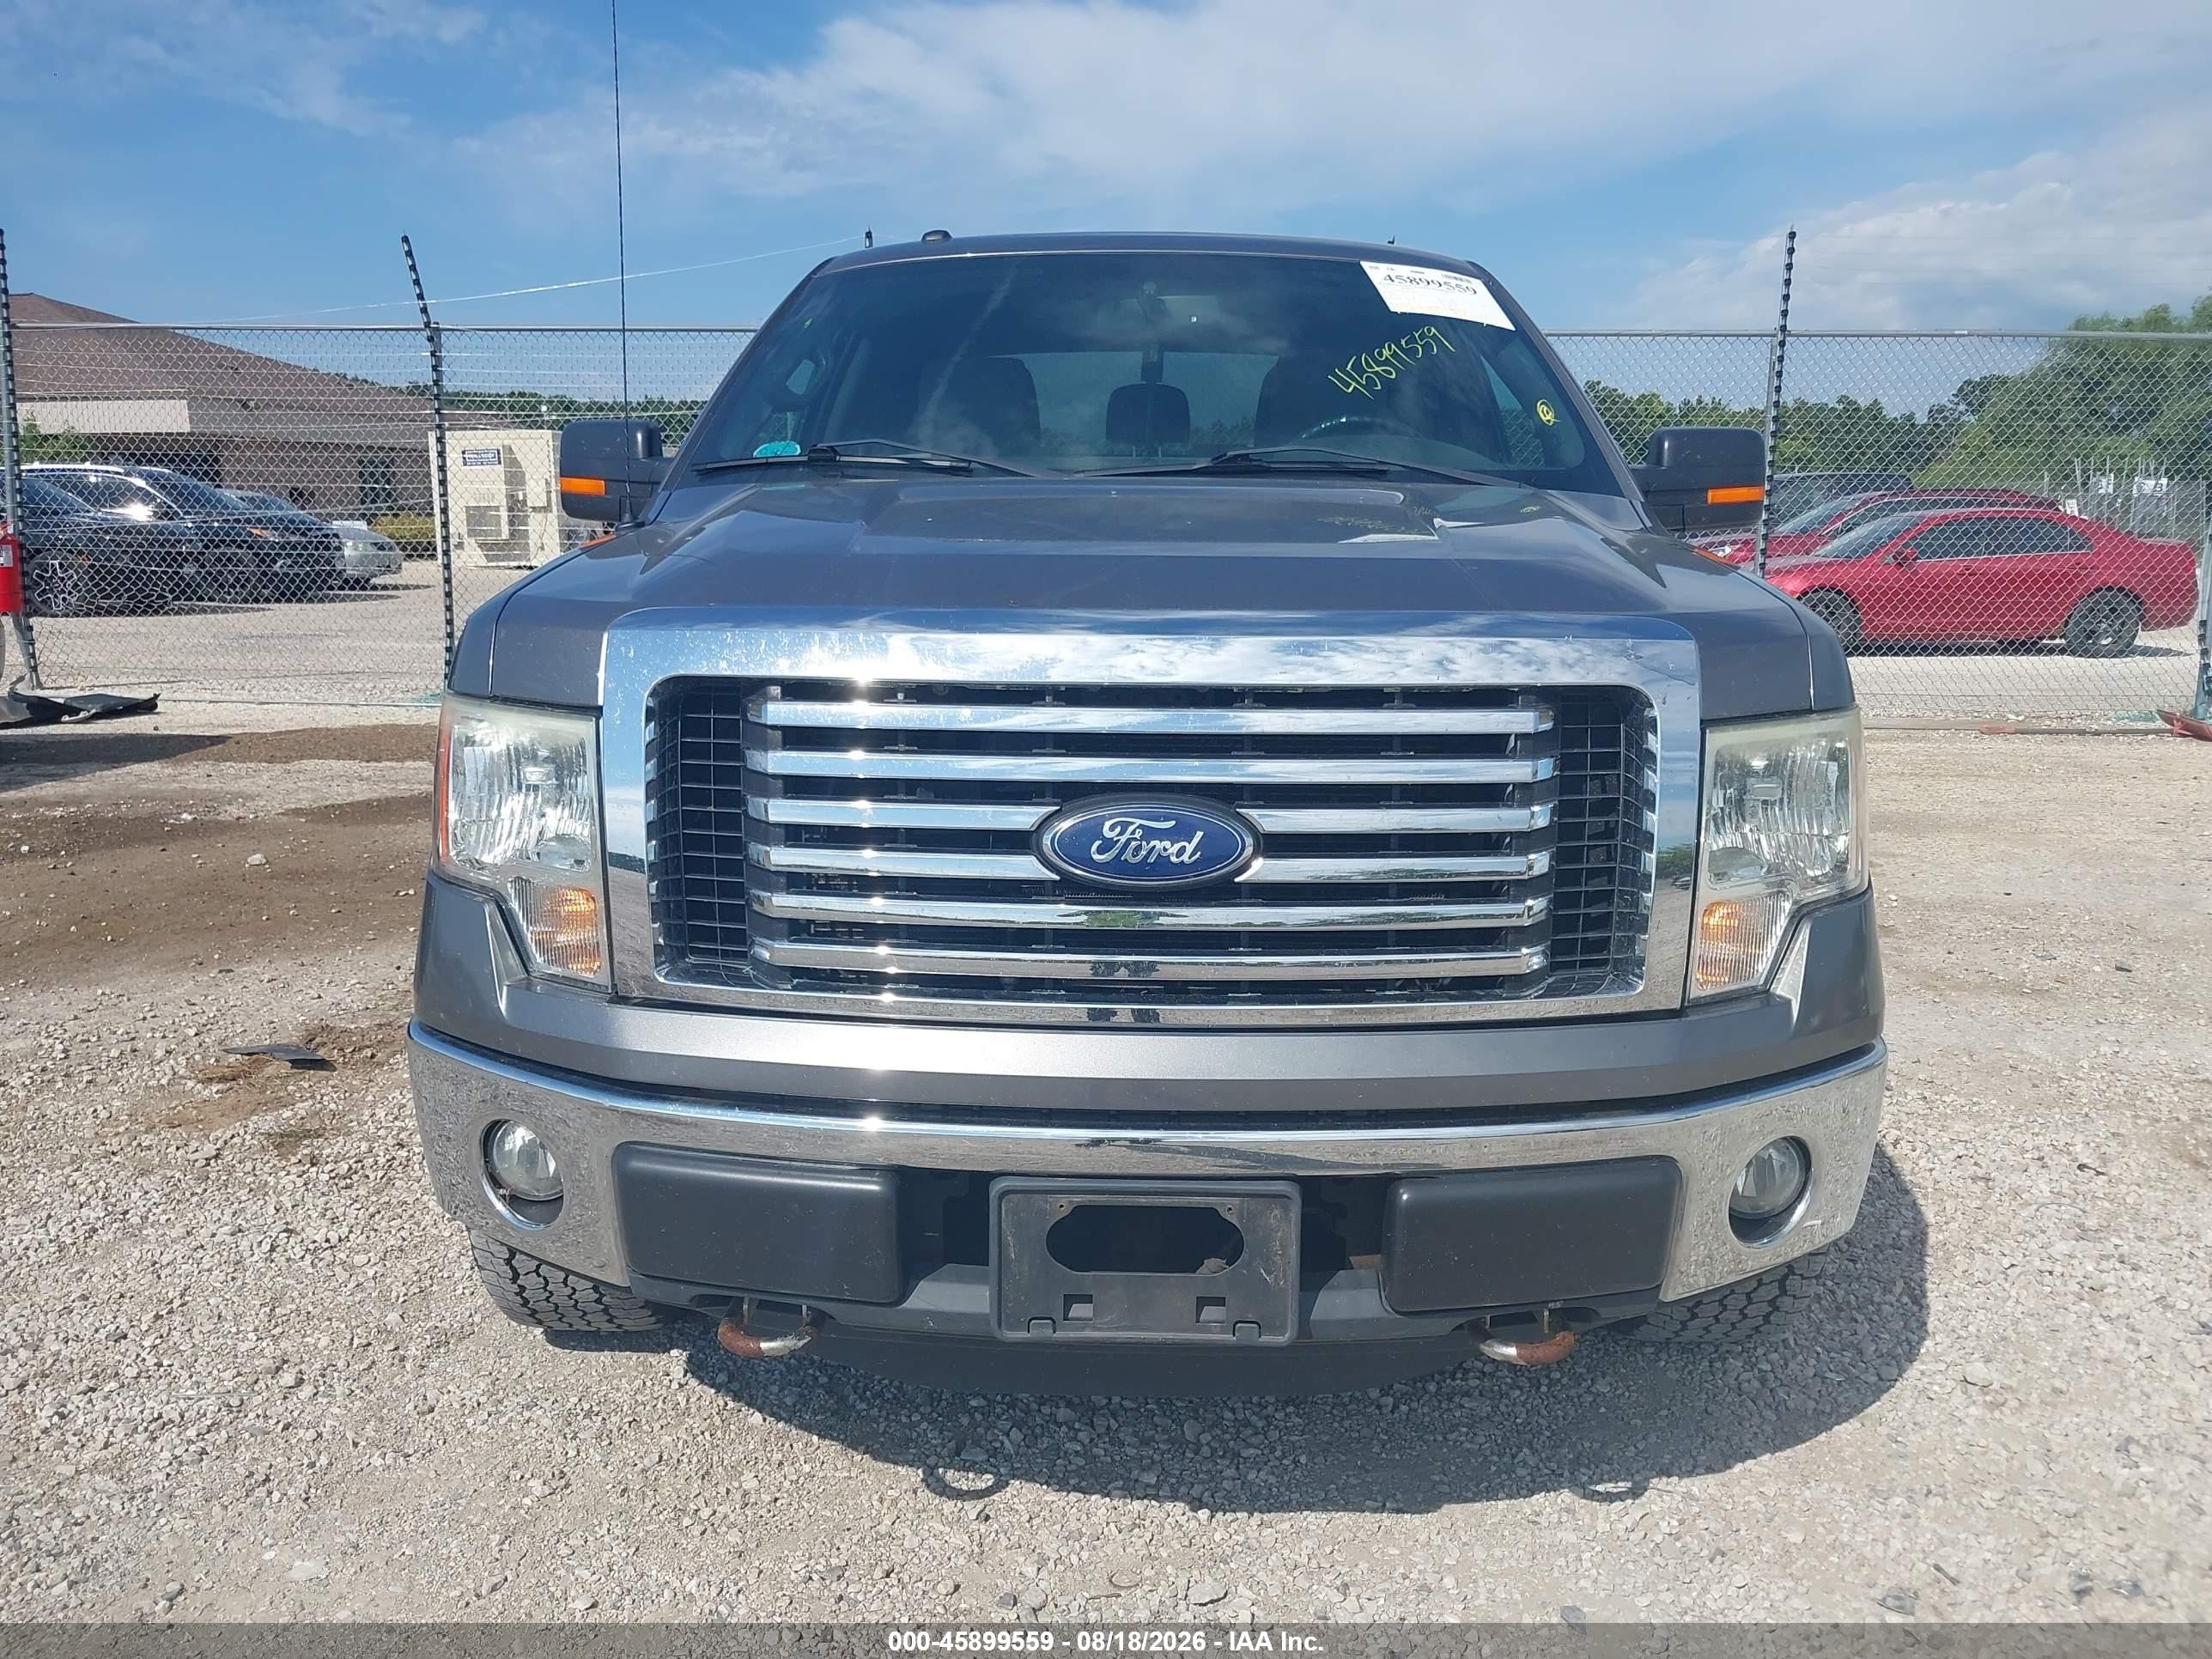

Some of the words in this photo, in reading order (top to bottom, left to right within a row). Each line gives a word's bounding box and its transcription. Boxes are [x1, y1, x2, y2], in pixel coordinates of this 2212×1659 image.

[1383, 274, 1477, 295] 45899559
[1328, 325, 1456, 400] 45899559
[1091, 817, 1204, 865] Ford
